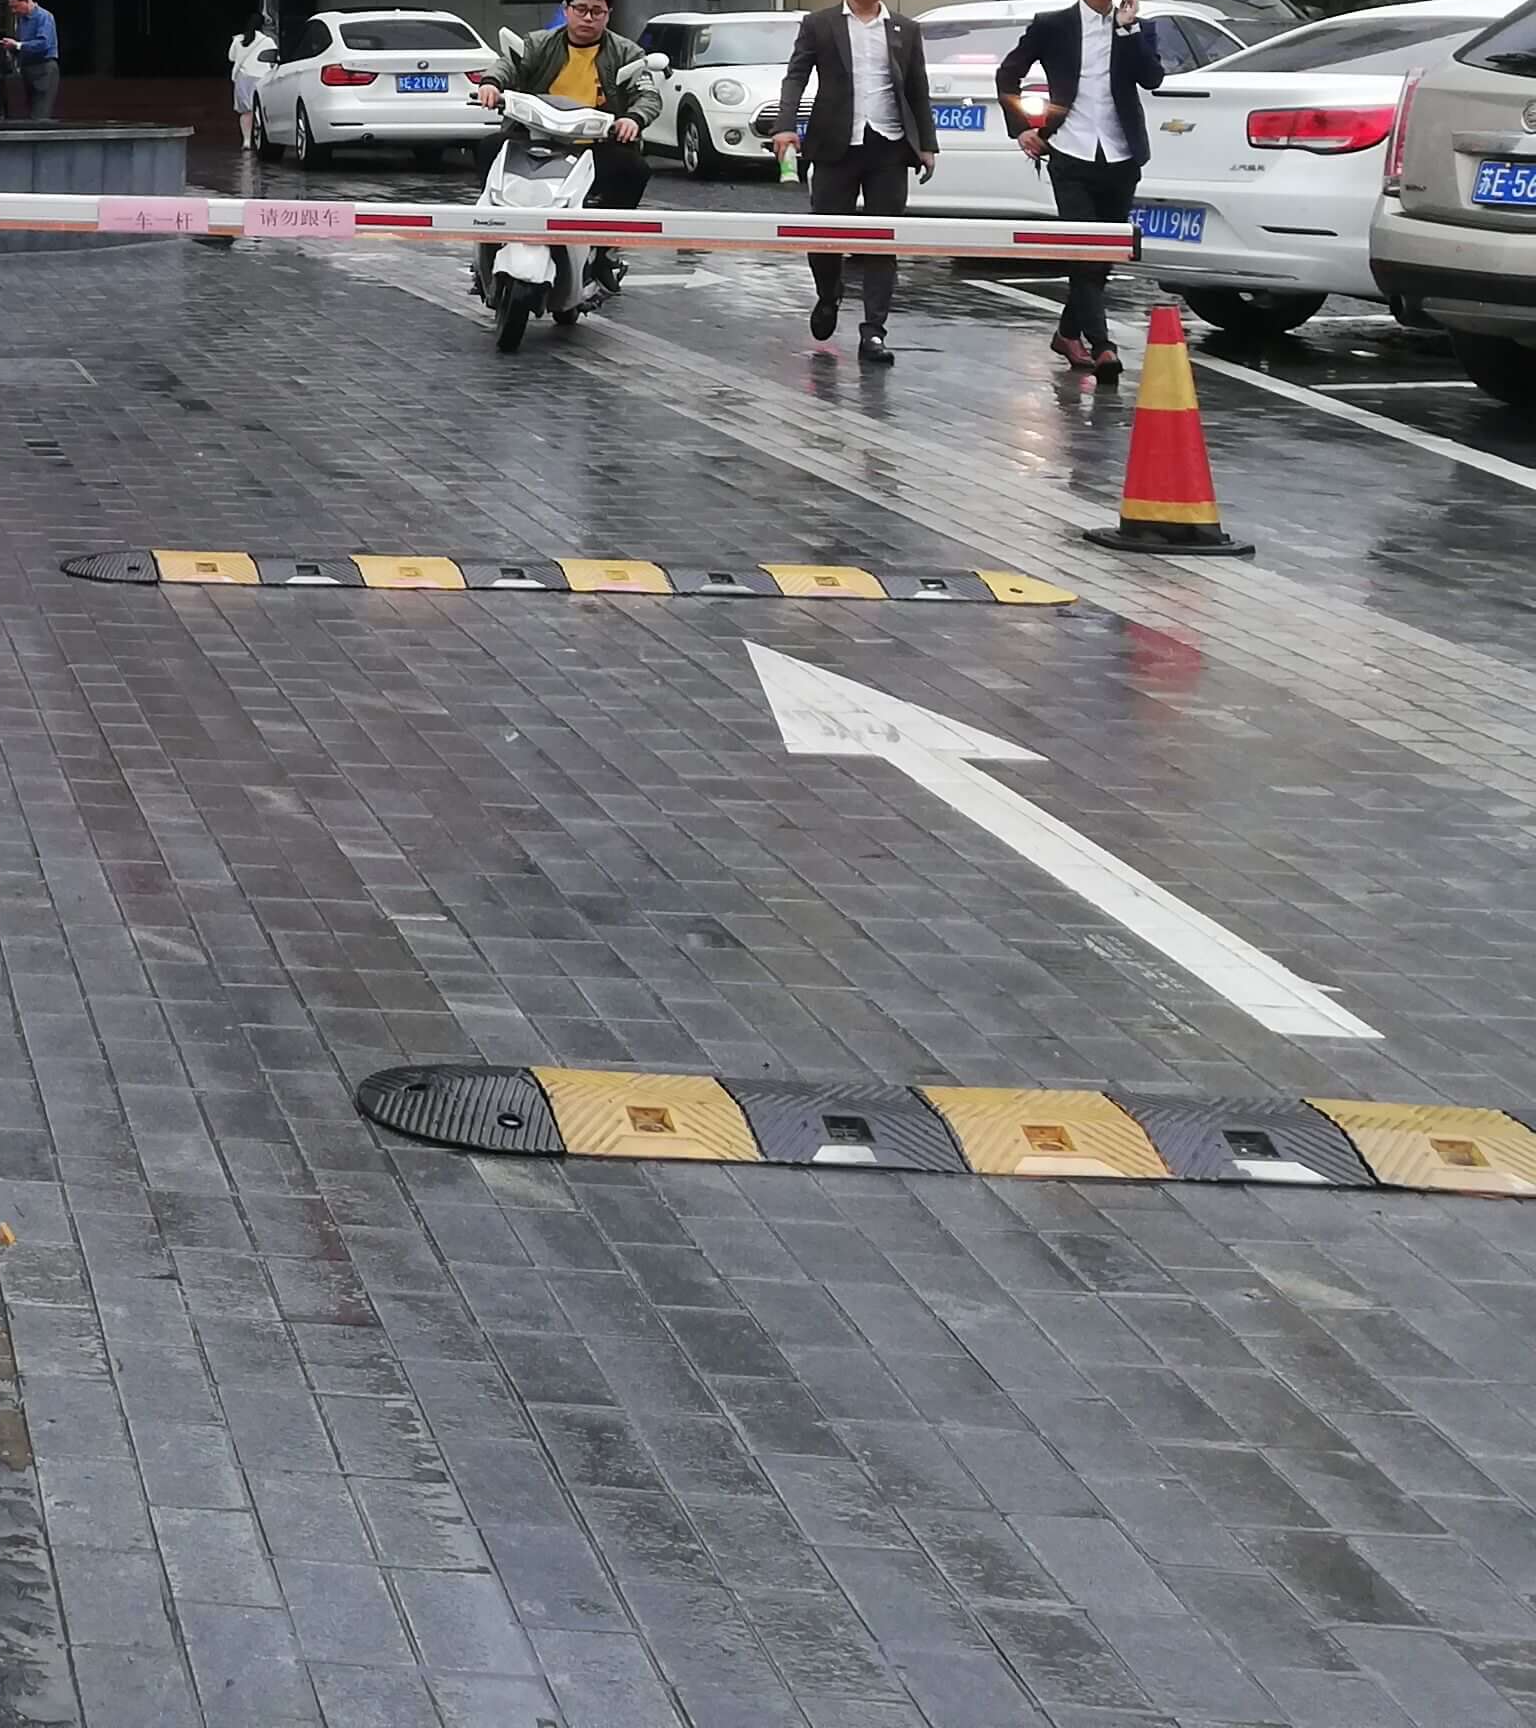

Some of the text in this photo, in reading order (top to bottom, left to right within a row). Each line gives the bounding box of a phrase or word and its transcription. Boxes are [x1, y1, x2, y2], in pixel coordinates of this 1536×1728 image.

[114, 210, 194, 230] 一车一杆
[259, 208, 341, 227] 请勿跟车
